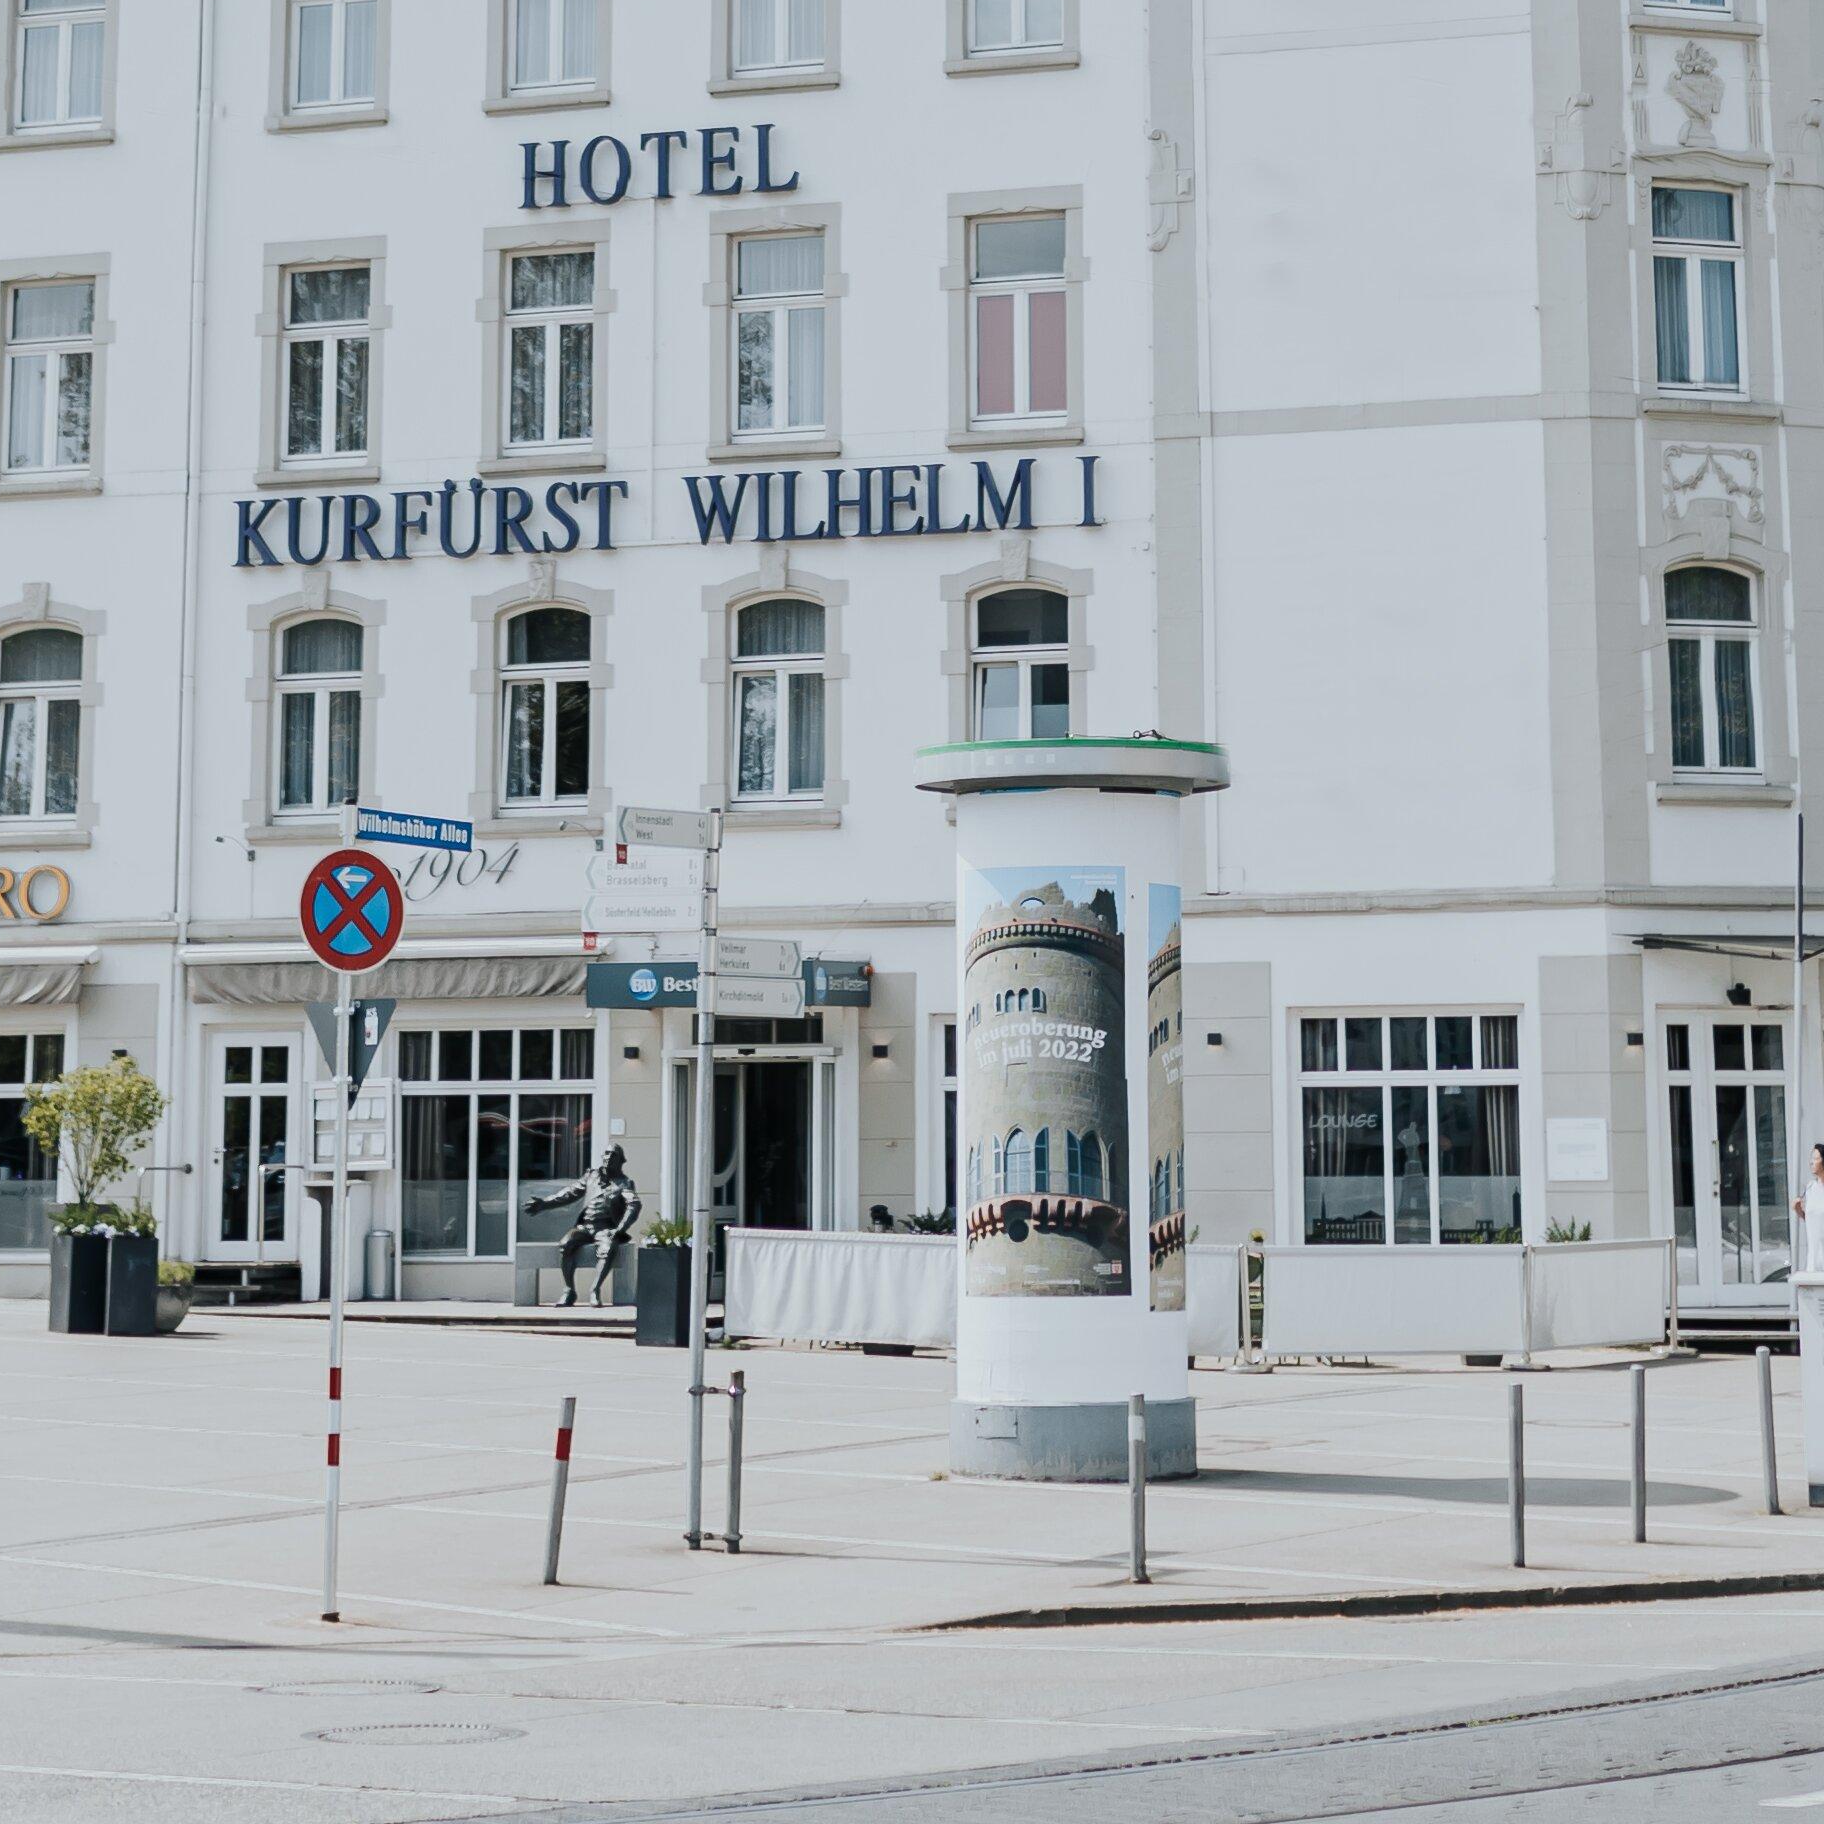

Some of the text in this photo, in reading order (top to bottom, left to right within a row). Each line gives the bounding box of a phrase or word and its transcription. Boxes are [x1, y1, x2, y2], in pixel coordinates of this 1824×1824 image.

[518, 123, 800, 209] HOTEL
[231, 456, 1104, 568] KURFÜRST WILHELM I
[358, 810, 469, 844] Wilhelmshöher Allee
[636, 814, 674, 826] Innenstadt
[636, 831, 654, 841] West
[405, 842, 519, 902] 1904
[606, 874, 668, 887] Brasselsberg
[720, 943, 747, 954] Vellmar
[663, 977, 699, 992] Best
[975, 1017, 1108, 1049] neueroberung
[977, 1039, 1093, 1070] im juli 2022
[1309, 1112, 1379, 1129] LOUNGE
